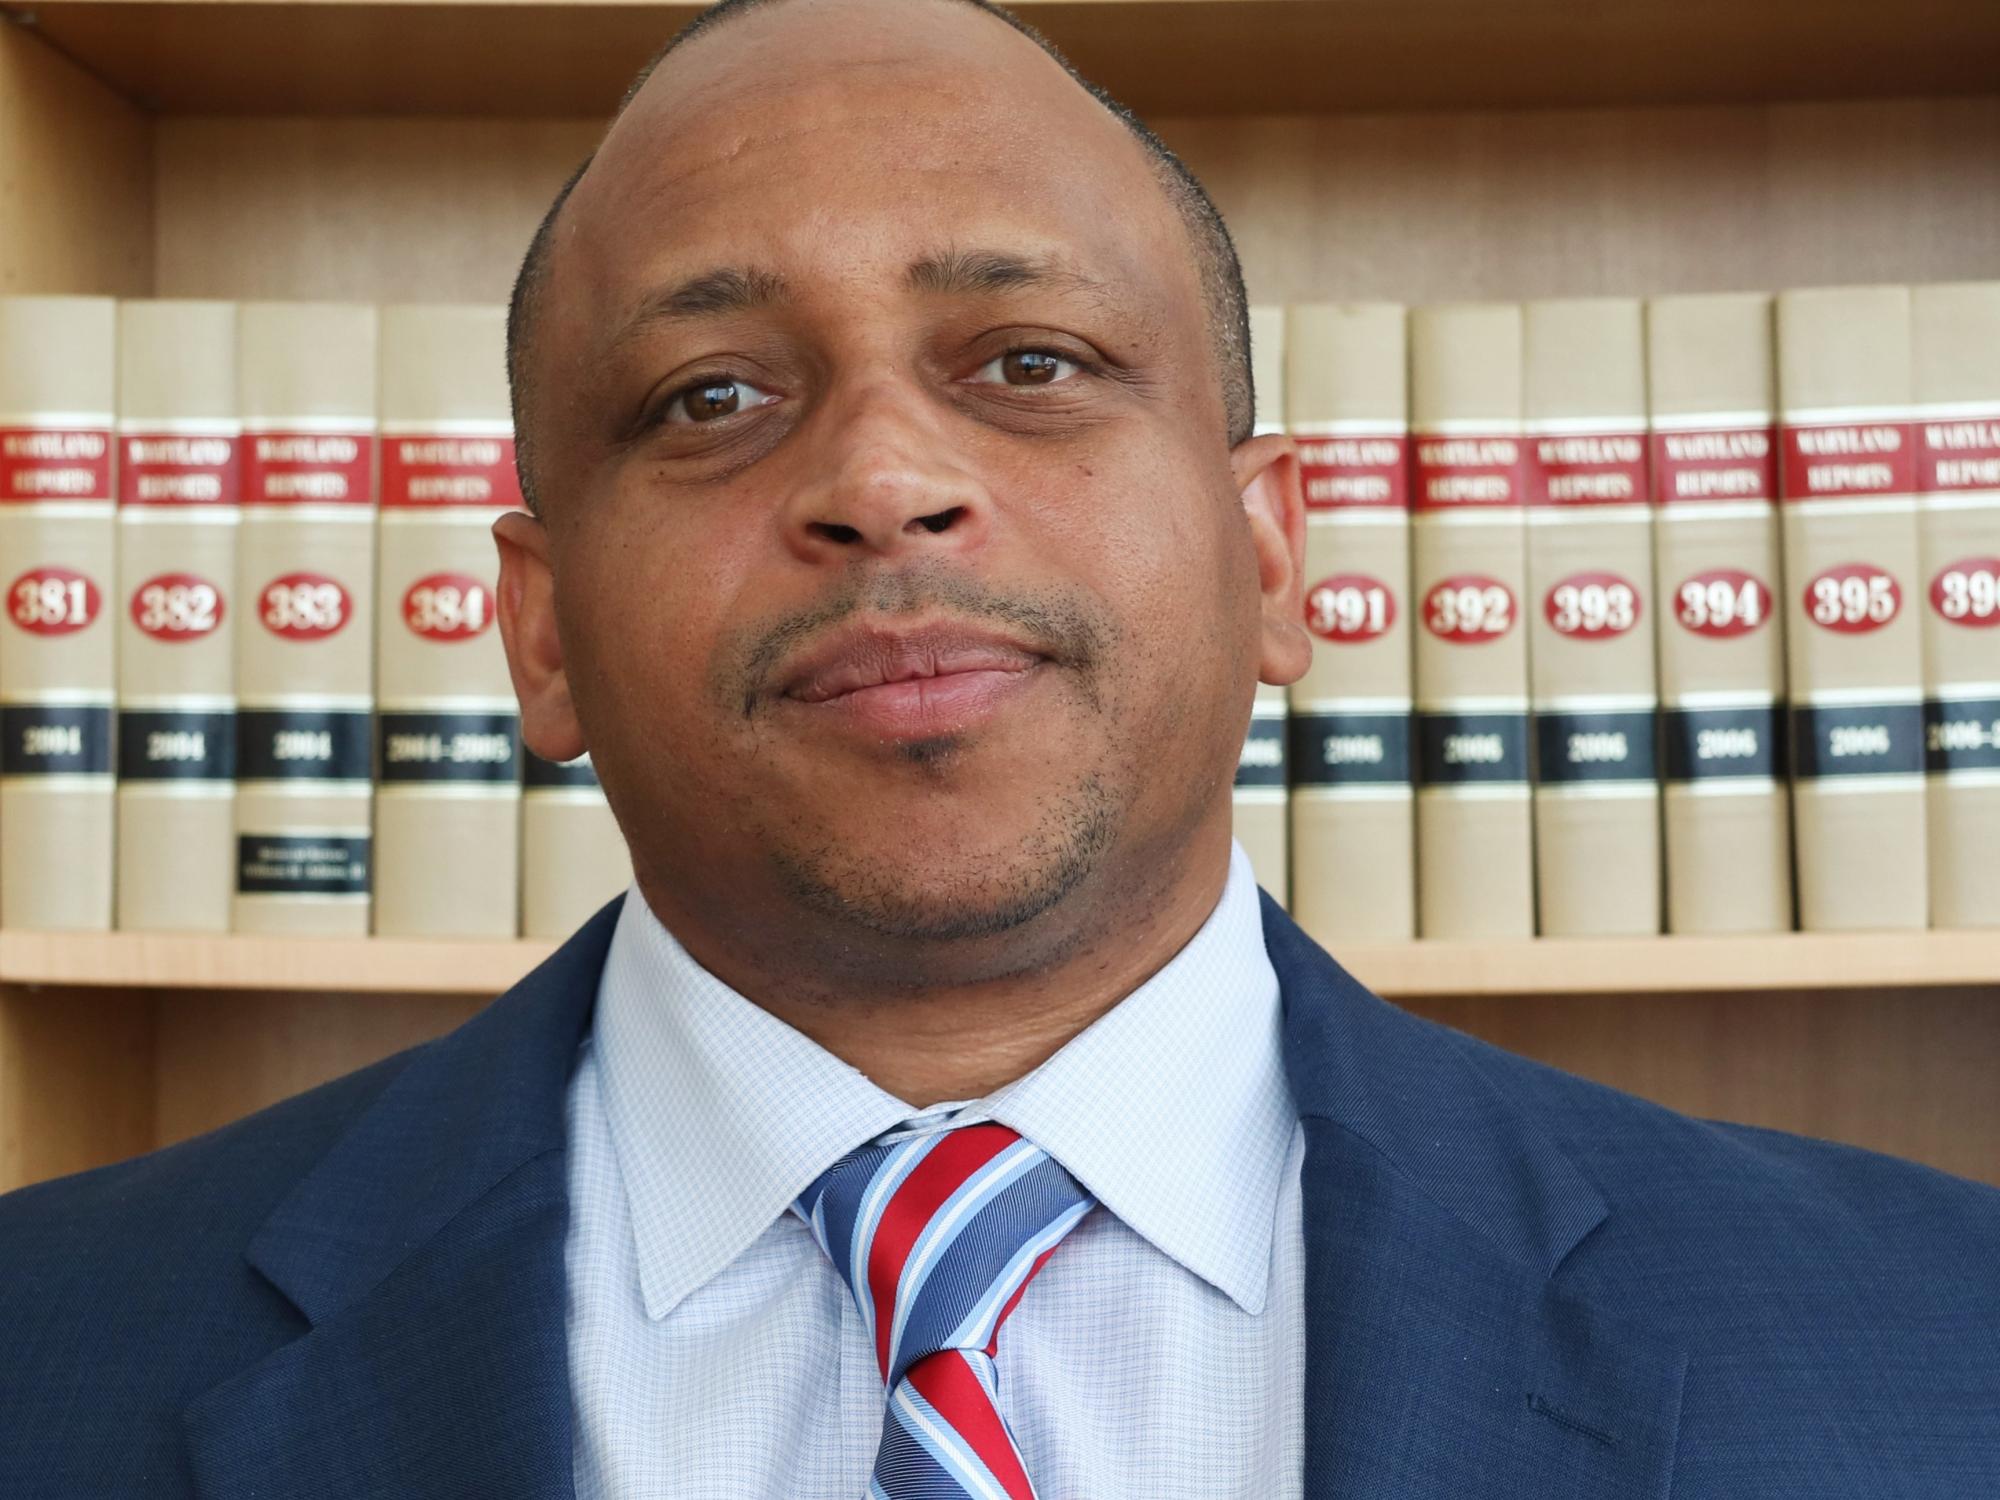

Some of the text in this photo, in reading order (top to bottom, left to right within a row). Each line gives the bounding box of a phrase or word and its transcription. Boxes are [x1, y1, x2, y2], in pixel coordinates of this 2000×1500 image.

[1925, 423, 2000, 449] MARYLA
[1936, 459, 2000, 485] REPOR
[16, 577, 87, 624] 381
[140, 584, 217, 631] 382
[266, 583, 342, 630] 383
[411, 585, 484, 632] 384
[1553, 584, 1634, 632] 393
[1681, 579, 1761, 628] 394
[1813, 576, 1895, 624] 395
[1942, 570, 2000, 618] 39
[1310, 587, 1385, 634] 391
[1431, 586, 1510, 633] 392
[23, 726, 82, 756] 2004
[147, 732, 205, 761] 2004
[273, 731, 331, 760] 2004
[1323, 735, 1383, 763] 2006
[1444, 734, 1504, 763] 2006
[1567, 732, 1628, 762] 2006
[1697, 729, 1757, 759] 2006
[1830, 726, 1890, 756] 2006
[1926, 719, 2000, 750] 2006-2
[1238, 738, 1282, 765] 006
